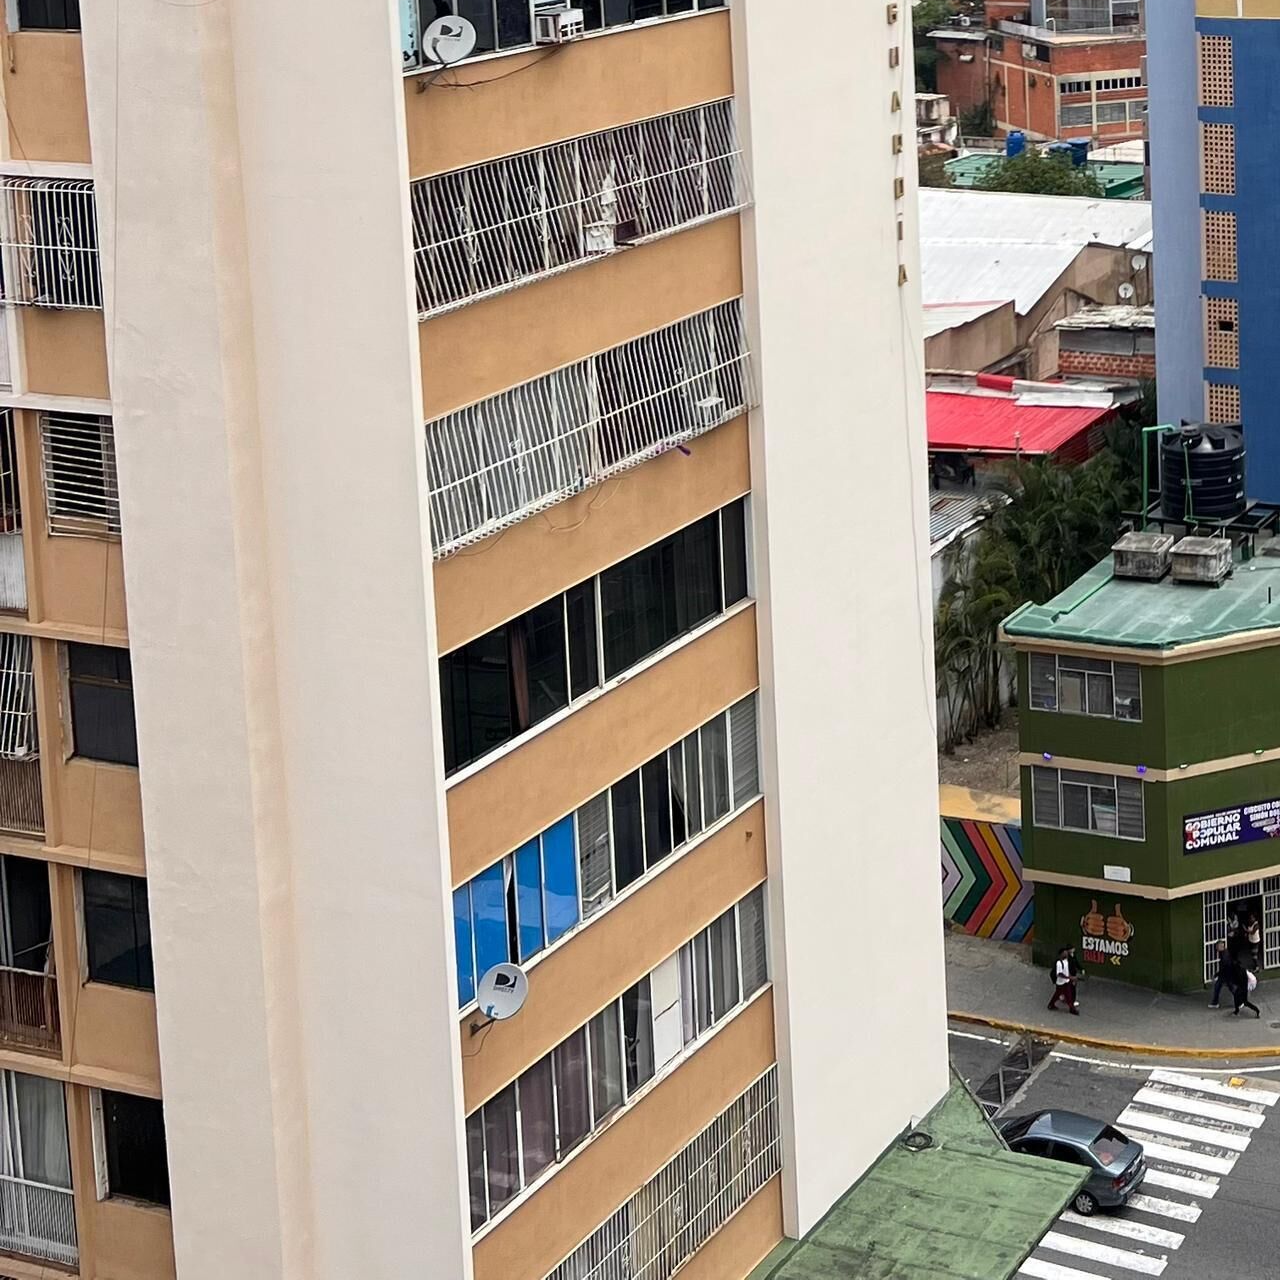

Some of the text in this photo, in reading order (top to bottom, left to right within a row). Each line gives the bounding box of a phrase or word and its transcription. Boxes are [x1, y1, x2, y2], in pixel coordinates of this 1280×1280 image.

[1185, 813, 1241, 831] GOBIERNO
[1192, 822, 1241, 840] POPULAR
[1185, 832, 1240, 850] COMUNAL
[1082, 936, 1129, 956] ESTAMOS
